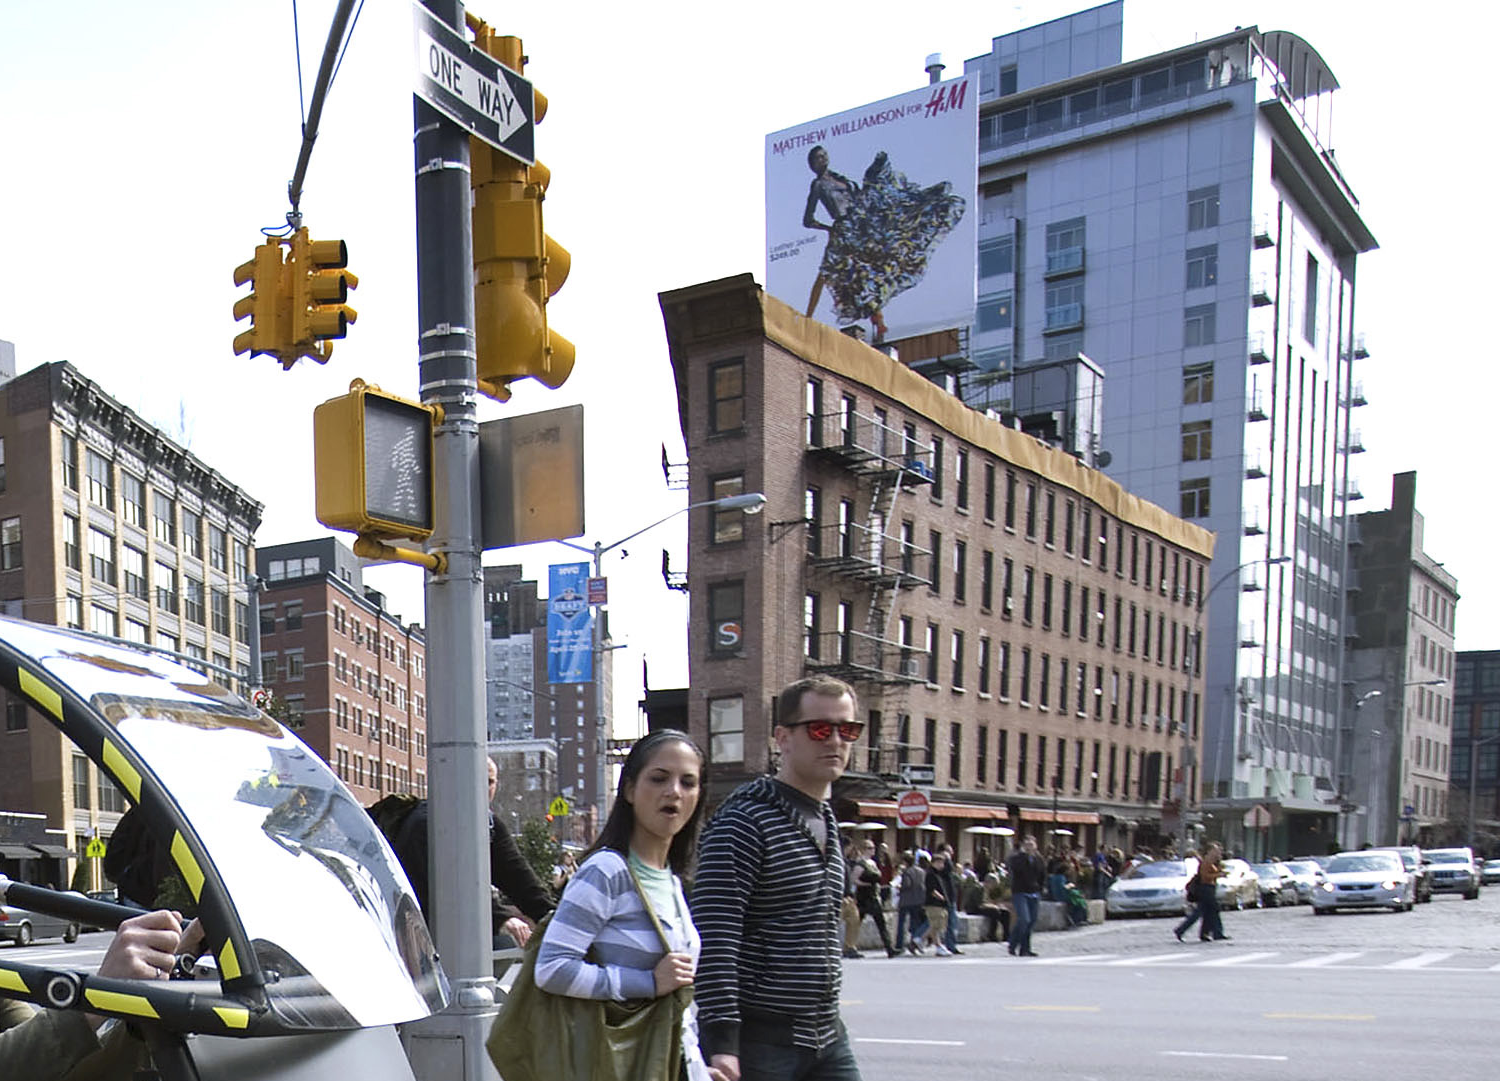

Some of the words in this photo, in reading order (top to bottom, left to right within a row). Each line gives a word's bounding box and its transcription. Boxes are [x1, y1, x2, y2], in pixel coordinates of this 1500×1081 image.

[429, 44, 463, 96] ONE
[477, 78, 514, 126] WAY
[773, 129, 827, 156] MATTHEW
[831, 107, 904, 137] WILLIAMSON
[907, 103, 923, 115] FOR
[924, 80, 968, 118] H&M
[718, 622, 739, 645] S
